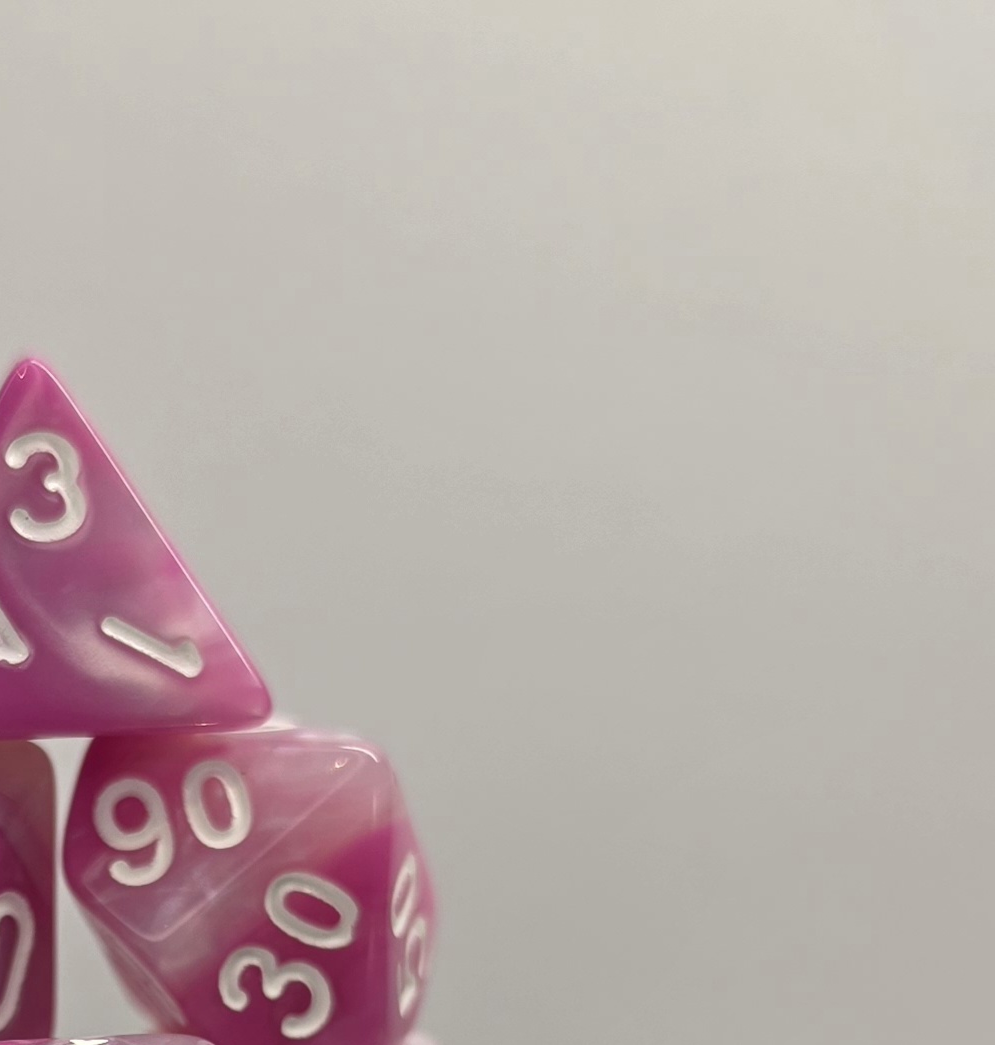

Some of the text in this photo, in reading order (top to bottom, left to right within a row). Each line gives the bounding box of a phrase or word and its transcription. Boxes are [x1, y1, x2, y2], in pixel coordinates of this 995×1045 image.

[4, 430, 89, 545] 3
[99, 613, 206, 680] 1
[93, 757, 255, 888] 90
[217, 872, 361, 1040] 30
